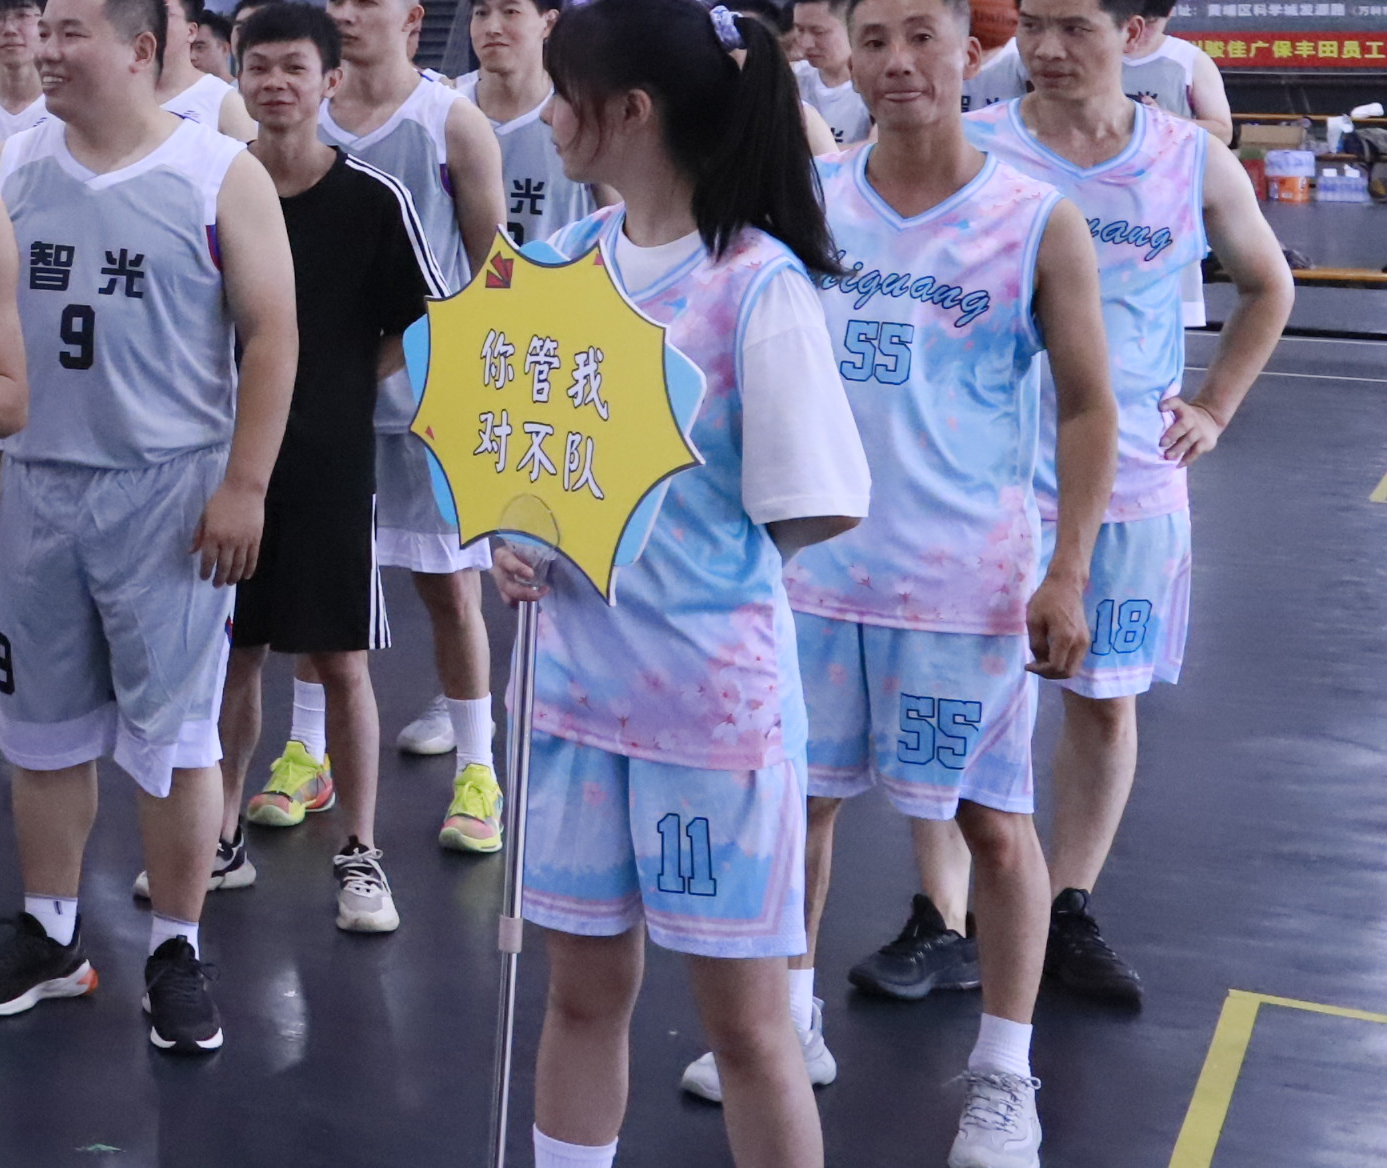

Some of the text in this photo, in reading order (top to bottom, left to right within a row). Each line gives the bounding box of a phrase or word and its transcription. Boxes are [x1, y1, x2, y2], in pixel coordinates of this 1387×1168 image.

[29, 240, 145, 299] 智光
[59, 303, 96, 370] 9
[839, 319, 914, 385] 55
[479, 327, 610, 421] 你管我
[471, 409, 605, 502] 对不队
[1090, 597, 1153, 656] 18
[896, 693, 984, 769] 55
[656, 812, 718, 898] 11
